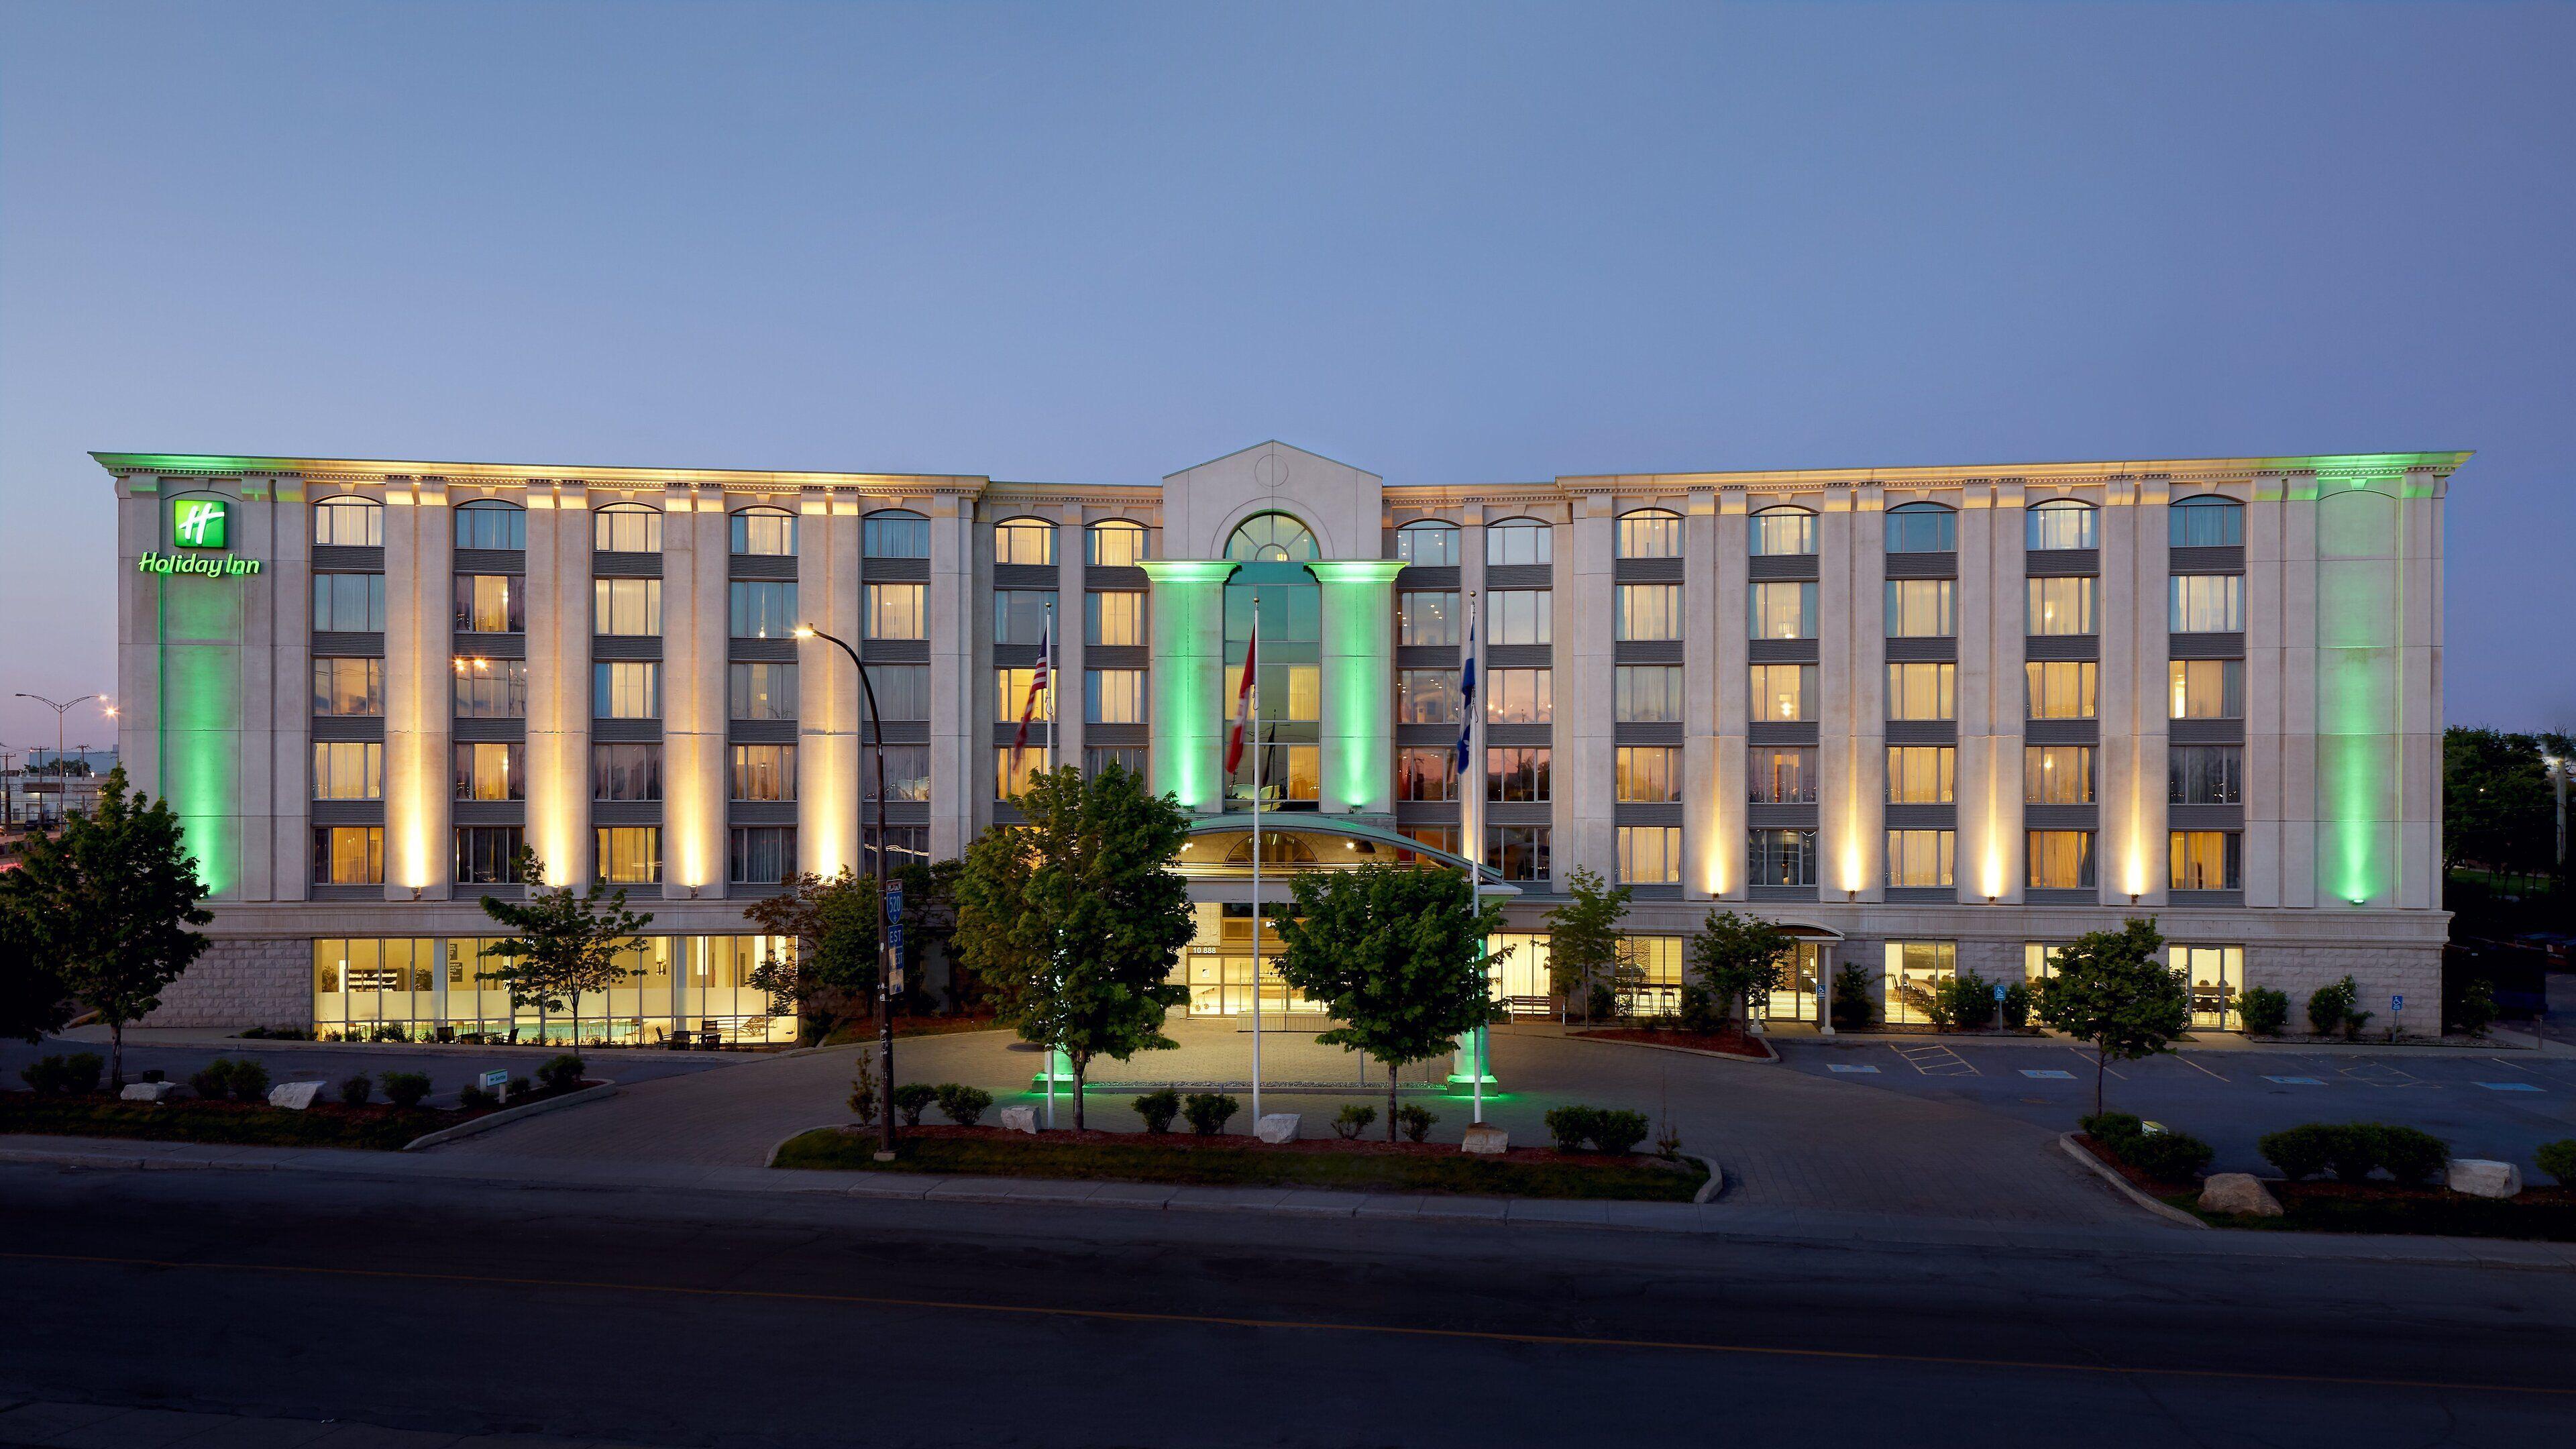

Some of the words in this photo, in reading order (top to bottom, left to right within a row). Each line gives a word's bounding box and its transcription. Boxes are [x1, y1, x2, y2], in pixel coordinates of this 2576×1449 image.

[138, 552, 223, 578] Holiday
[226, 553, 261, 575] Inn
[890, 896, 901, 913] 520
[890, 930, 902, 943] EST
